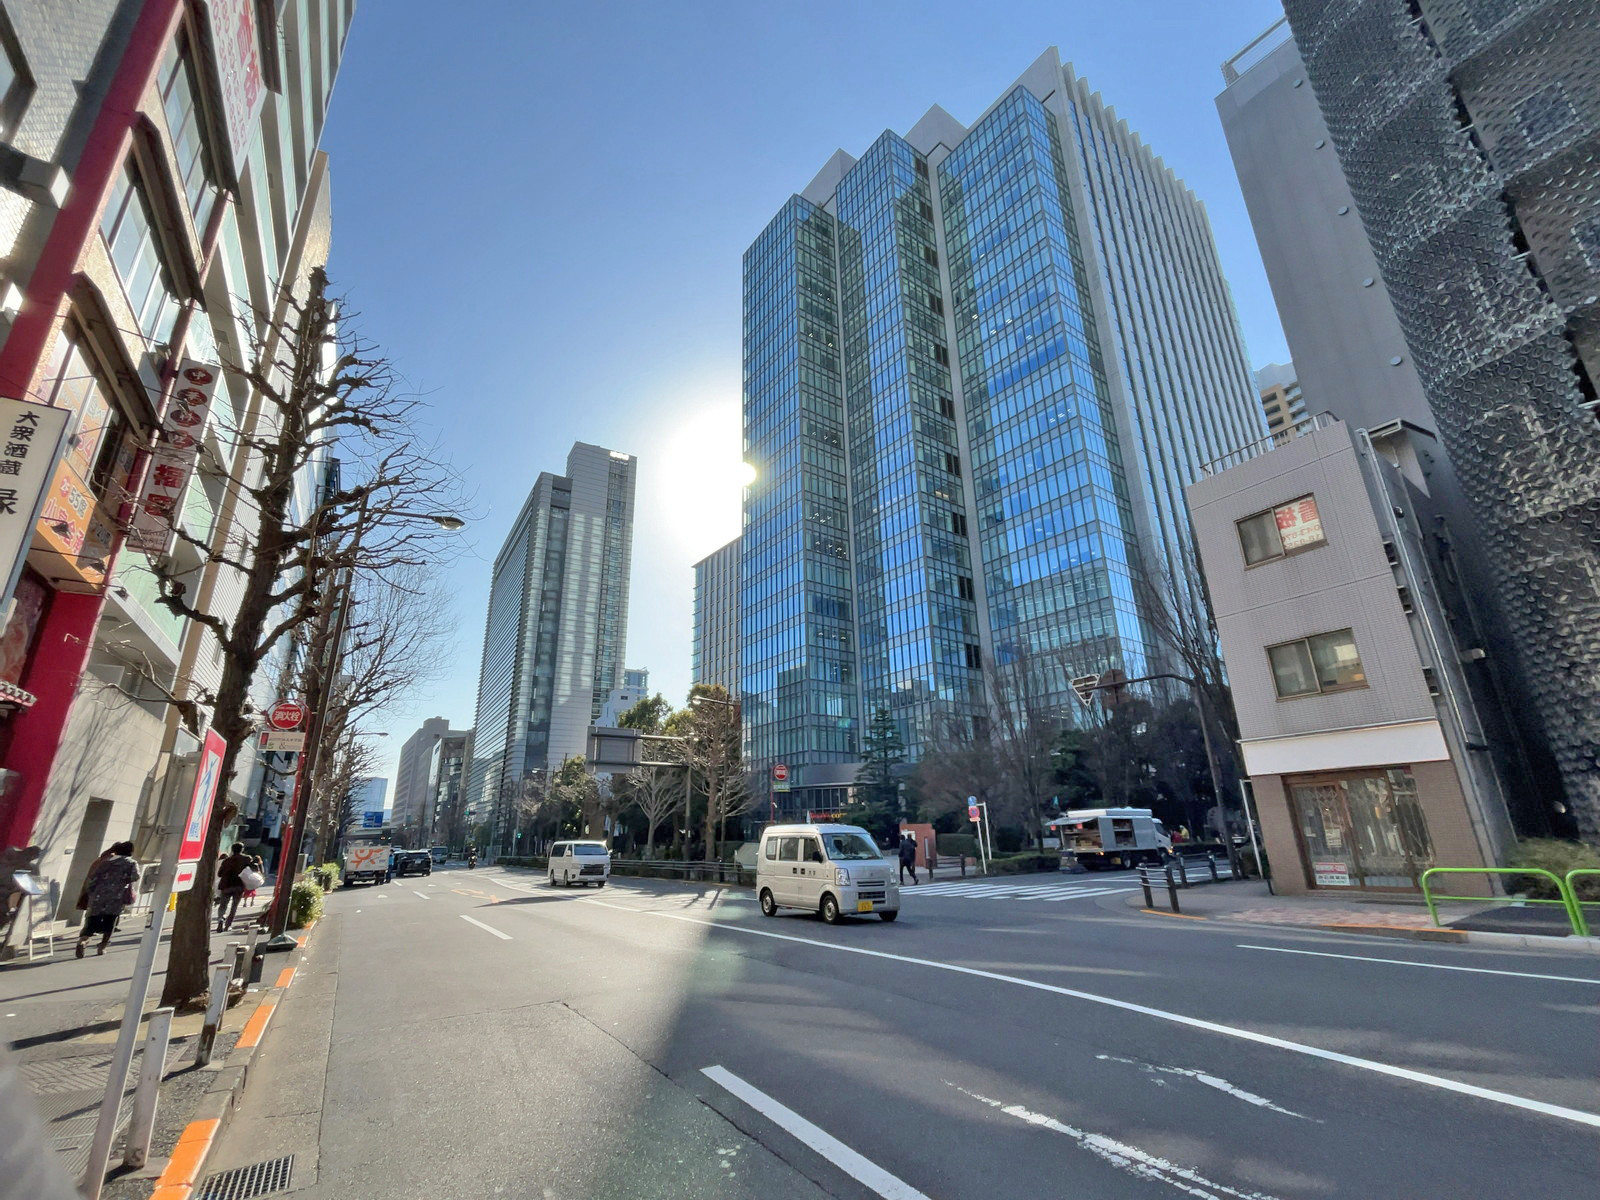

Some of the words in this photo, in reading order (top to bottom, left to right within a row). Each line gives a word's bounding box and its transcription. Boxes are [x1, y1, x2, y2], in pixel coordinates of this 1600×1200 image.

[0, 411, 40, 476] 大衆酒蔵
[274, 711, 300, 721] 消火栓
